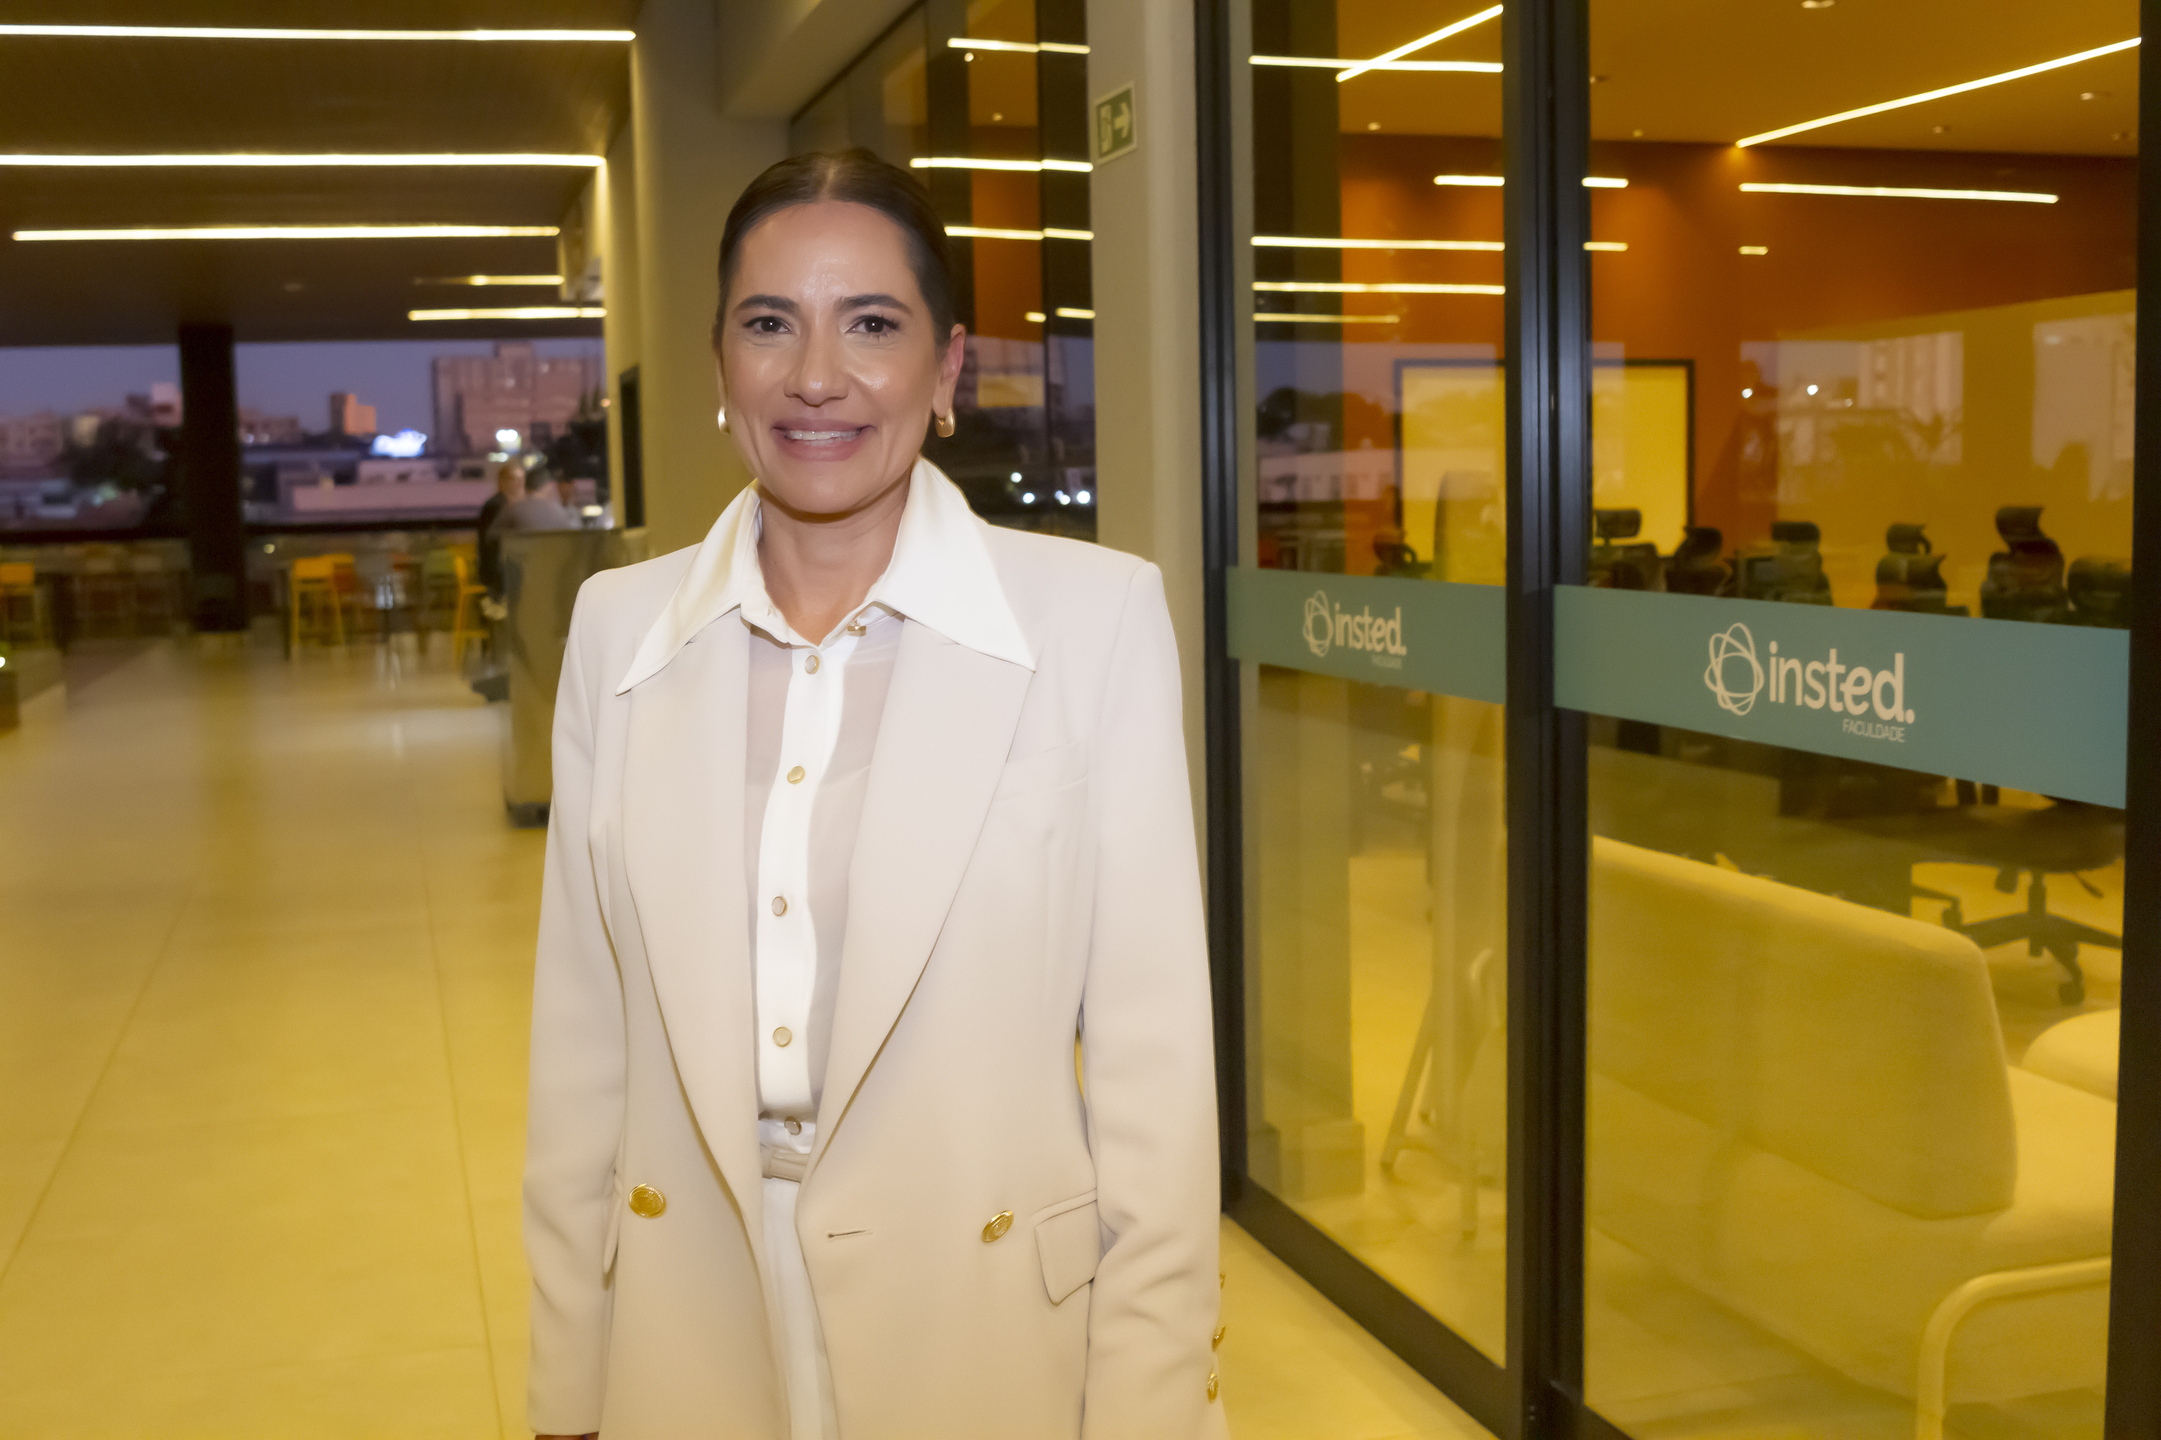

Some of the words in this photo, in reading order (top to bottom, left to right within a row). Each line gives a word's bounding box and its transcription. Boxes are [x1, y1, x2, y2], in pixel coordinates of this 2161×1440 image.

[1335, 602, 1407, 656] insted.
[1769, 640, 1915, 724] insted.
[1842, 718, 1905, 743] FACULDADE
